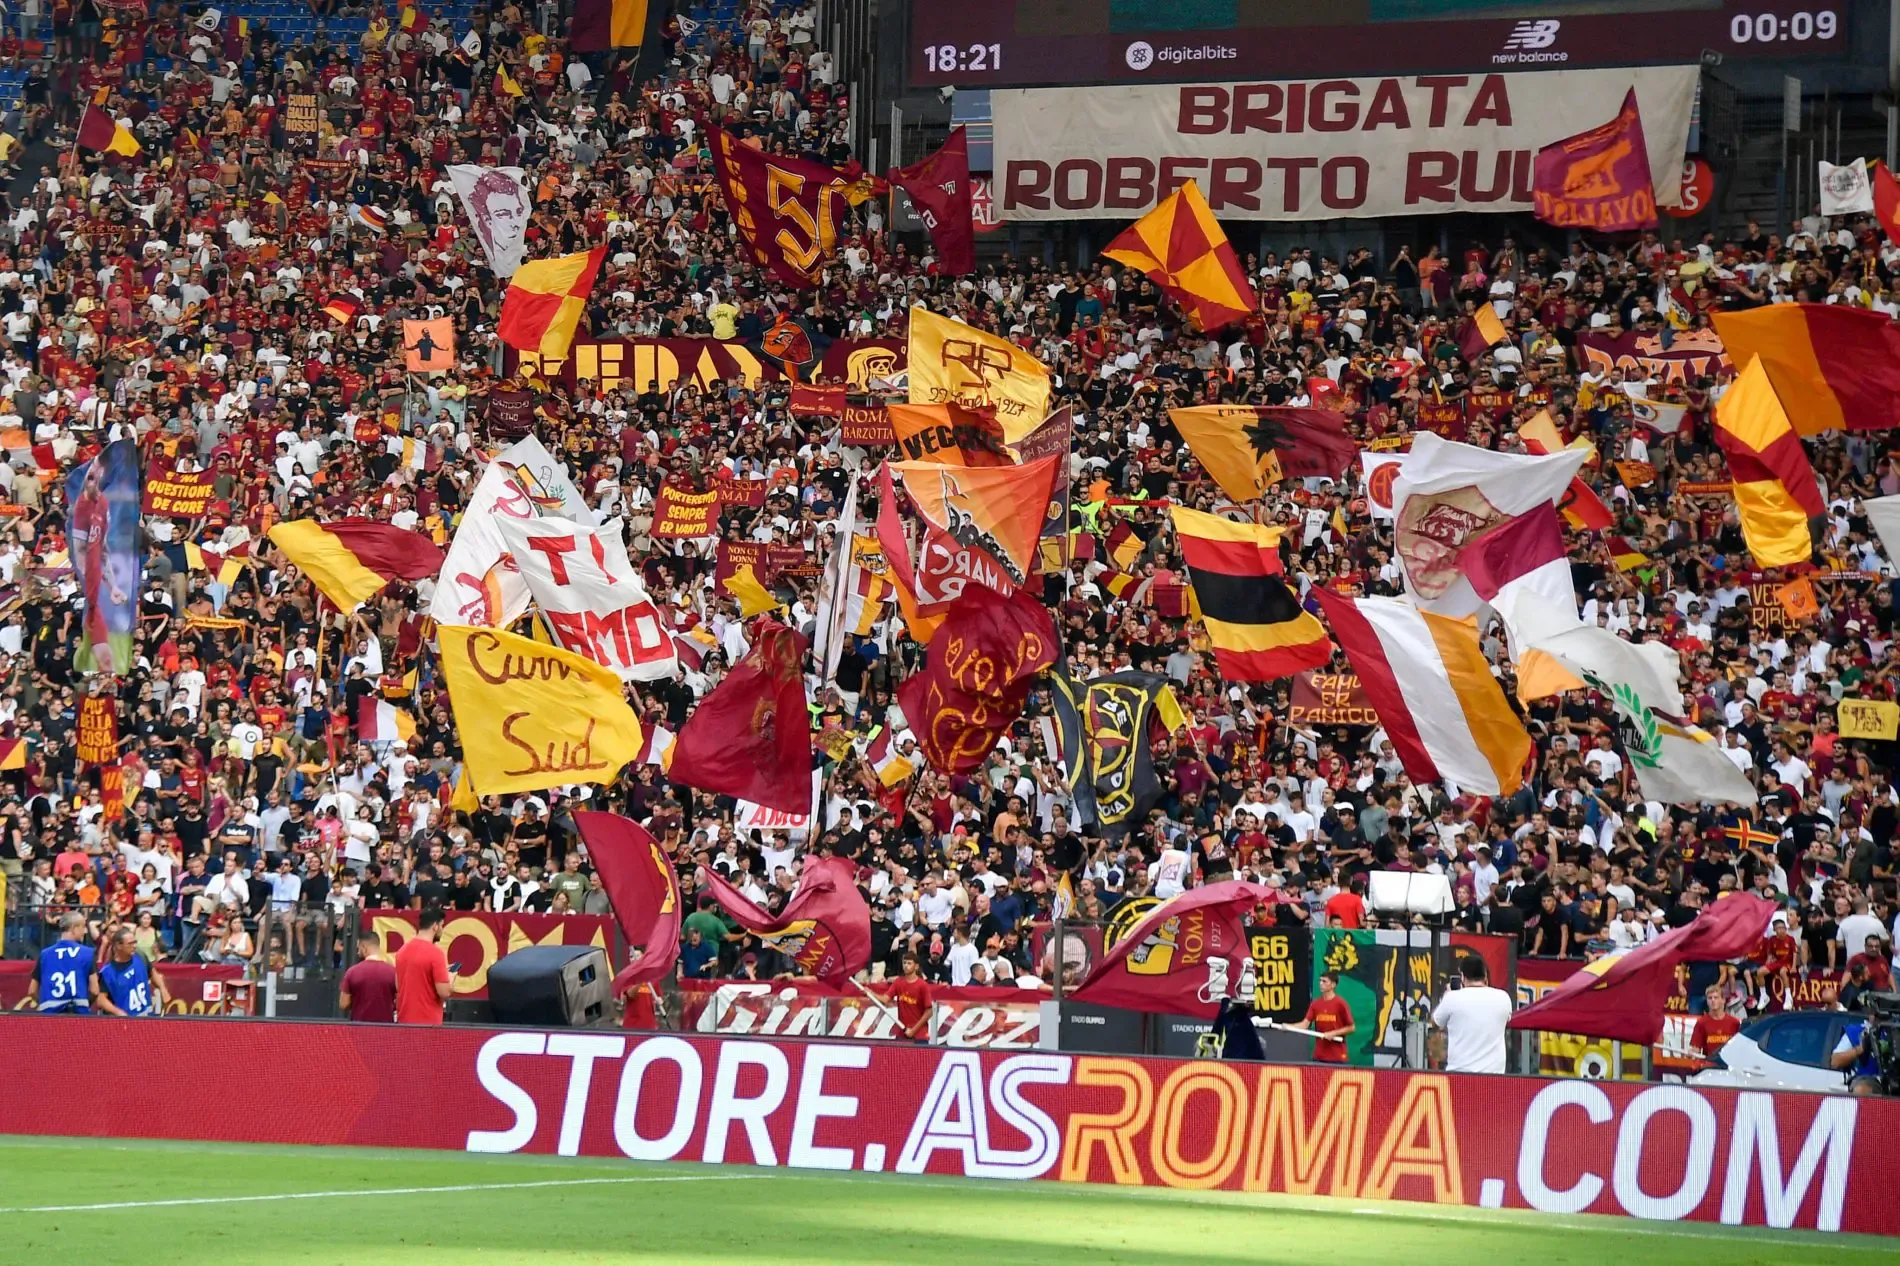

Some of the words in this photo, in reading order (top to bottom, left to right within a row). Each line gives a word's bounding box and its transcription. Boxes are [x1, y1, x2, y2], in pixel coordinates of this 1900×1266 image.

[1730, 11, 1838, 43] 00:09
[923, 43, 1001, 72] 18:21
[1158, 45, 1238, 64] digitalbits
[1492, 53, 1517, 64] new
[1519, 51, 1569, 63] balance
[286, 107, 318, 120] GIALLO
[1176, 74, 1513, 135] BRIGATA
[285, 119, 317, 132] ROSSO
[1003, 156, 1370, 212] ROBERTO
[843, 426, 894, 440] BARZOTTA
[147, 480, 213, 498] QUESTIONE
[733, 480, 763, 491] SOLA
[662, 486, 718, 505] PORTEREMO
[721, 490, 750, 502] MAI
[151, 496, 172, 511] DE
[171, 500, 206, 514] CORE
[667, 505, 709, 520] SEMPRE
[659, 520, 672, 534] ER
[673, 522, 708, 534] VANTO
[527, 532, 618, 586] TI
[727, 545, 746, 556] NON
[729, 554, 758, 564] DONNA
[545, 600, 675, 669] AMO
[1321, 691, 1351, 708] ER
[1290, 705, 1379, 724] PANICO
[80, 730, 112, 747] COSA
[501, 712, 608, 777] Sud
[77, 743, 98, 764] NON
[54, 946, 81, 960] TV
[1251, 935, 1289, 960] 66
[123, 969, 136, 979] TV
[1254, 960, 1295, 985] CON
[50, 971, 78, 999] 31
[1254, 985, 1292, 1012] NOI
[1172, 1024, 1194, 1033] STADIO
